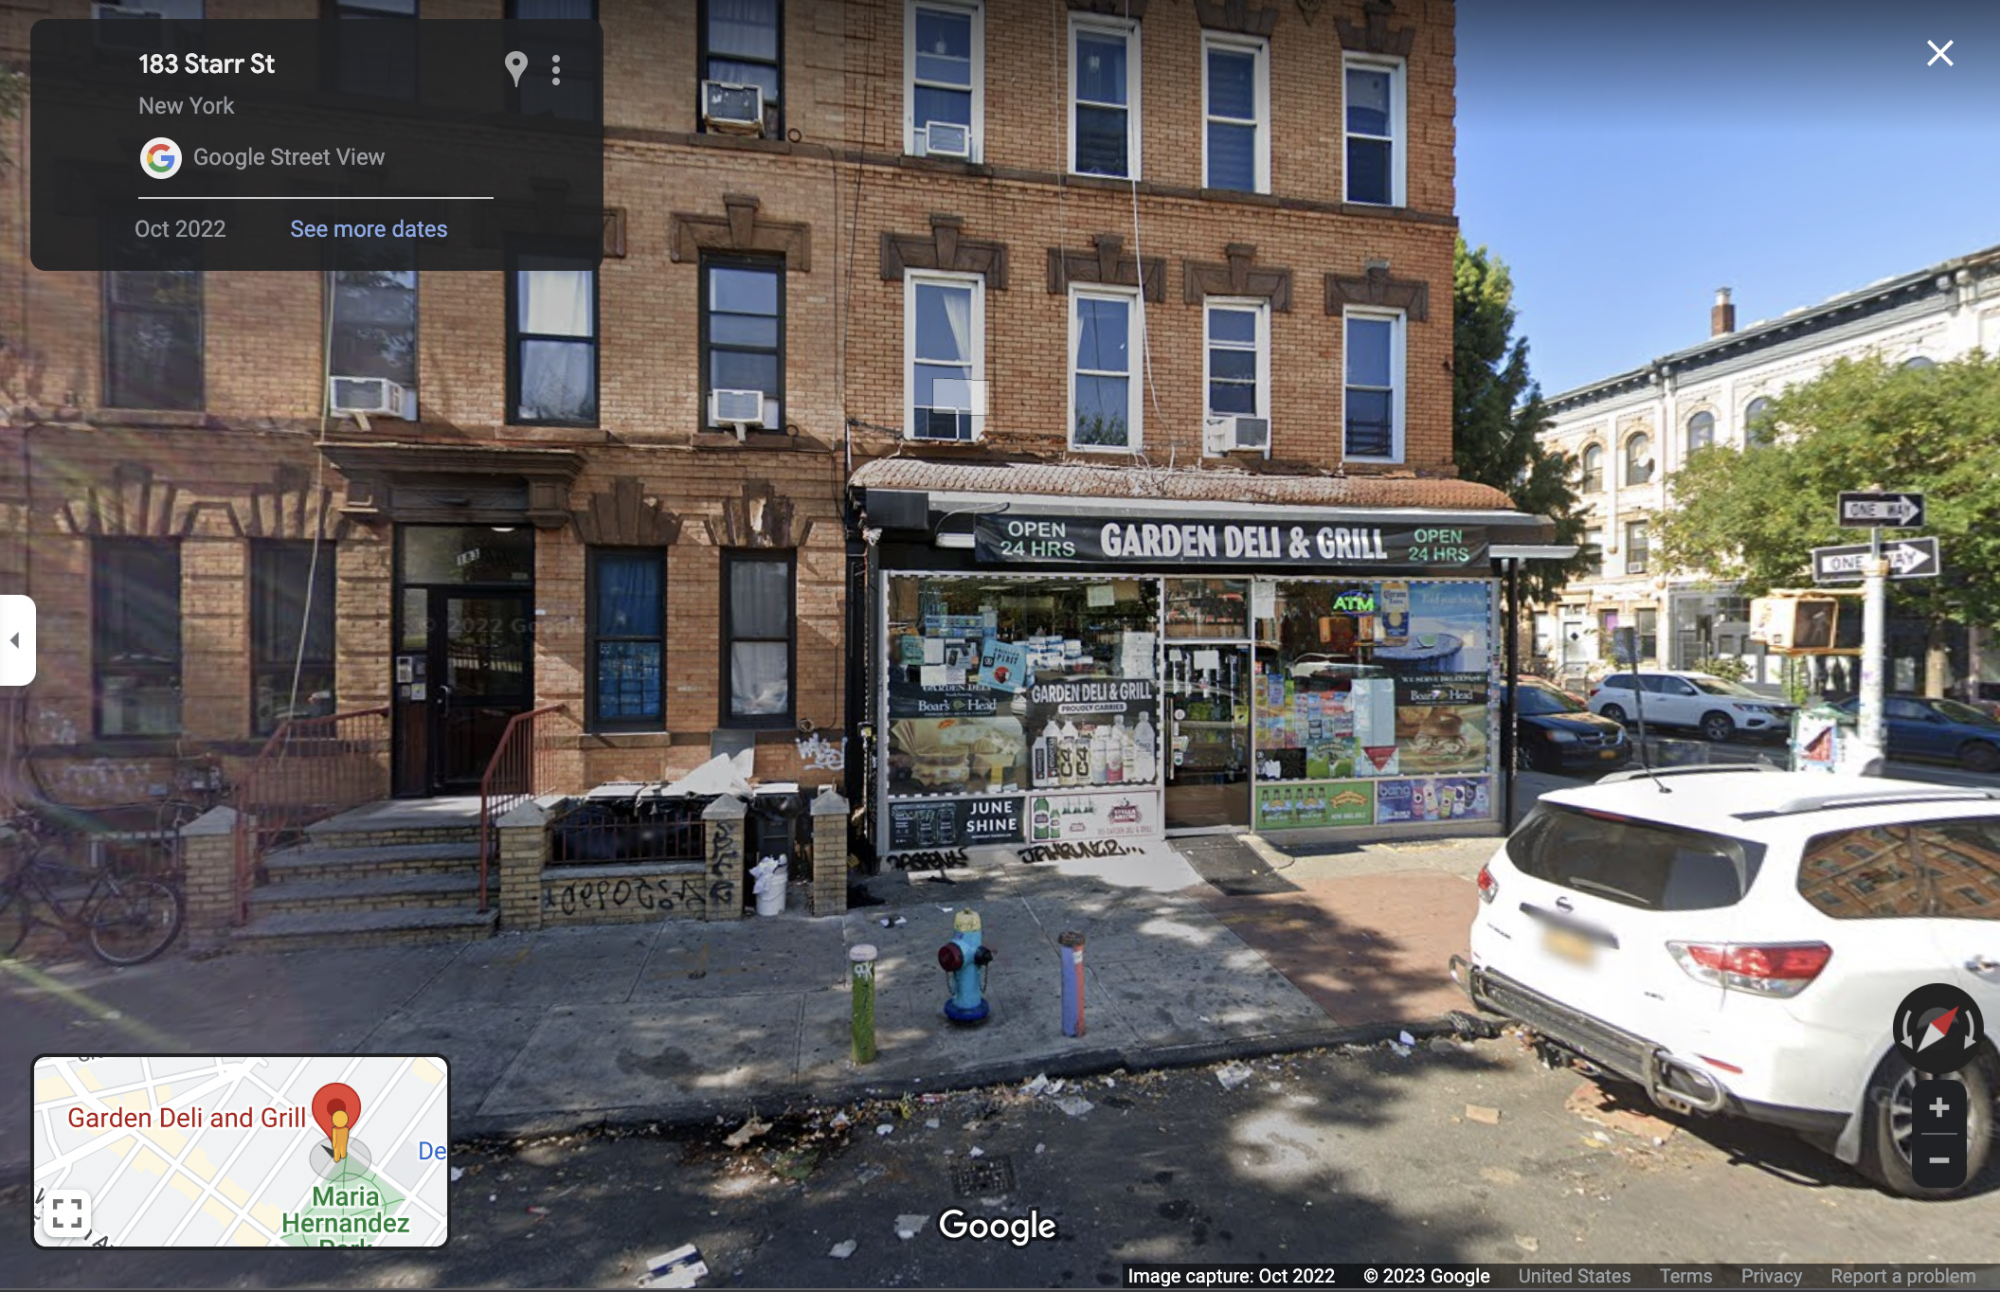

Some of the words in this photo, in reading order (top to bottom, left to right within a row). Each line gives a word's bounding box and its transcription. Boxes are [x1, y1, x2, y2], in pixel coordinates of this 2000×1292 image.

[1850, 503, 1876, 516] ONE
[1887, 503, 1913, 516] WAY
[1007, 520, 1066, 538] OPEN
[1414, 528, 1463, 544] OPEN
[1000, 540, 1025, 556] 24
[1031, 541, 1076, 557] HRS
[1100, 523, 1217, 557] GARDEN
[1224, 525, 1281, 558] DELI
[1289, 526, 1311, 559] &
[1316, 527, 1388, 559] GRILL
[1408, 546, 1429, 561] 24
[1433, 547, 1470, 562] HRS
[1830, 555, 1864, 571] ONE
[1333, 596, 1375, 612] ATM
[1032, 683, 1080, 703] GARDEN
[1082, 683, 1107, 702] DELI
[1109, 682, 1118, 700] &
[1119, 681, 1152, 700] GRILL
[1449, 690, 1473, 700] Head
[918, 699, 950, 712] Boar's
[968, 698, 997, 711] Head
[1062, 704, 1093, 712] PROUDLY
[1094, 703, 1124, 712] CARRIES
[1060, 747, 1073, 778] C4
[1076, 746, 1089, 777] C4
[1379, 784, 1411, 798] bang
[970, 800, 1013, 816] JUNE
[966, 817, 1017, 833] SHINE
